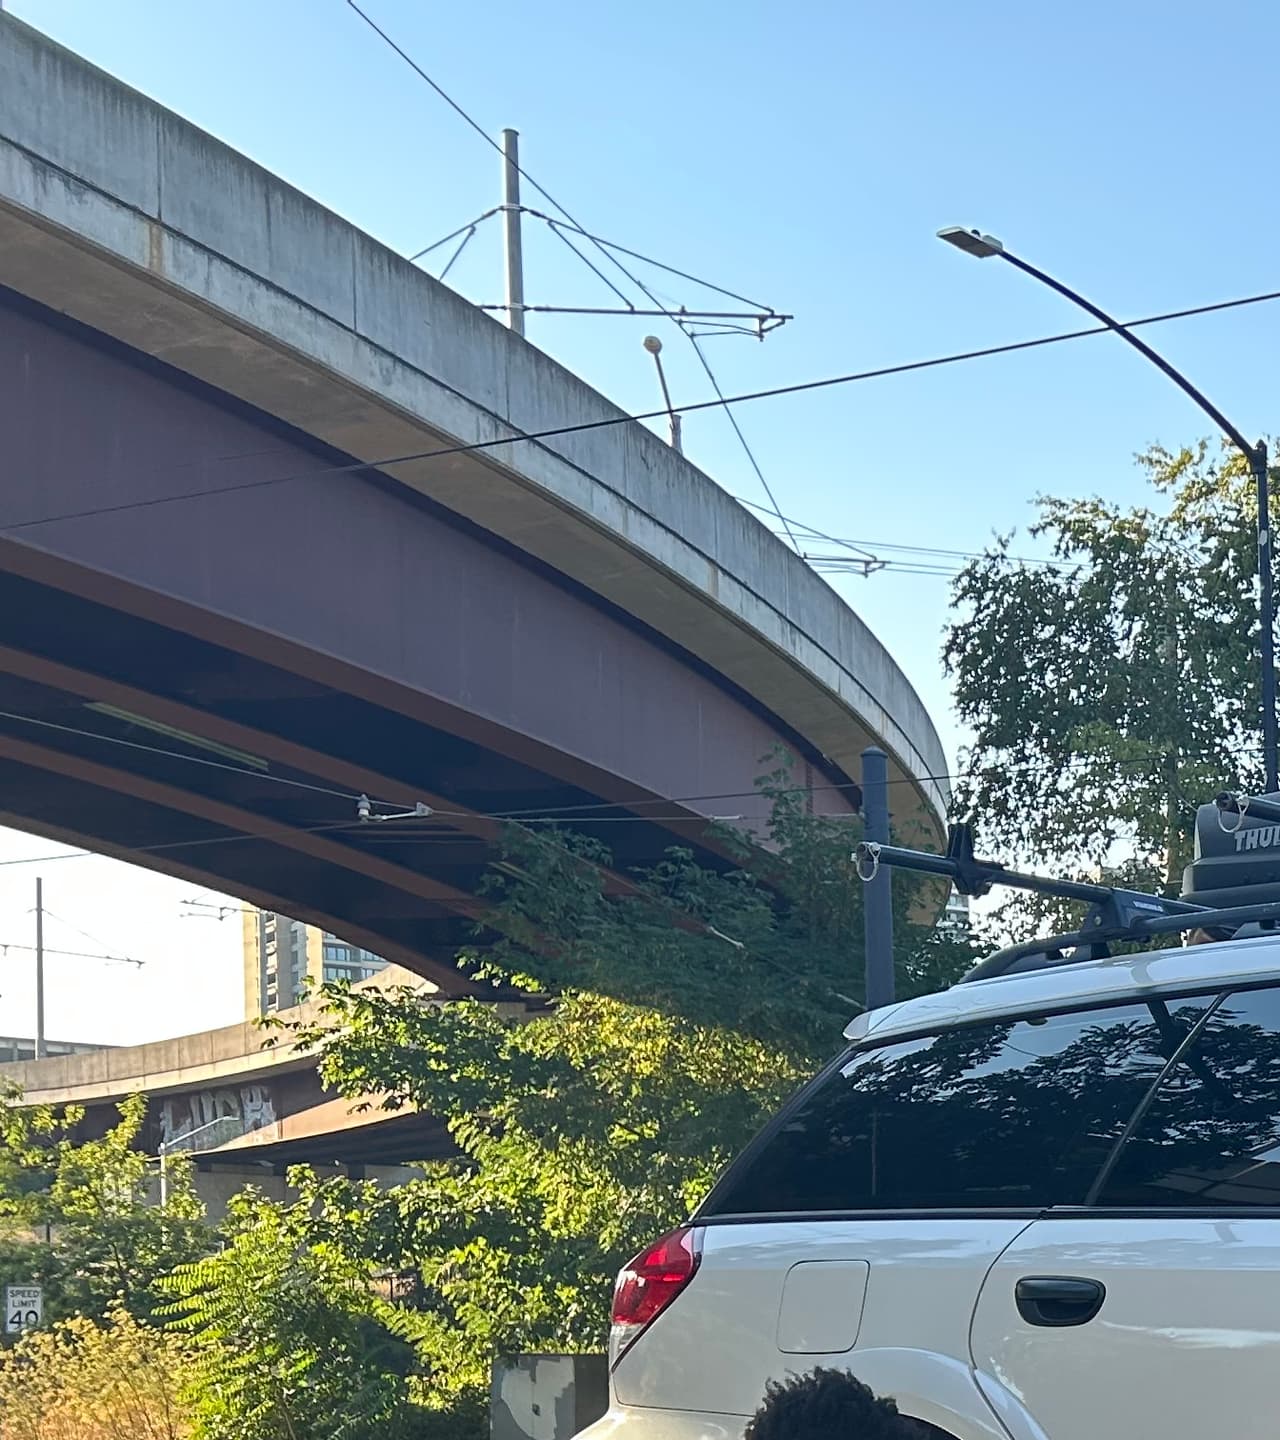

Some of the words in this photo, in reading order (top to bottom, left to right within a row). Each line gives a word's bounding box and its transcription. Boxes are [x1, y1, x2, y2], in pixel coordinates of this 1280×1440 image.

[9, 1290, 39, 1298] SPEED
[12, 1299, 37, 1308] LIMIT
[9, 1310, 39, 1328] 40
